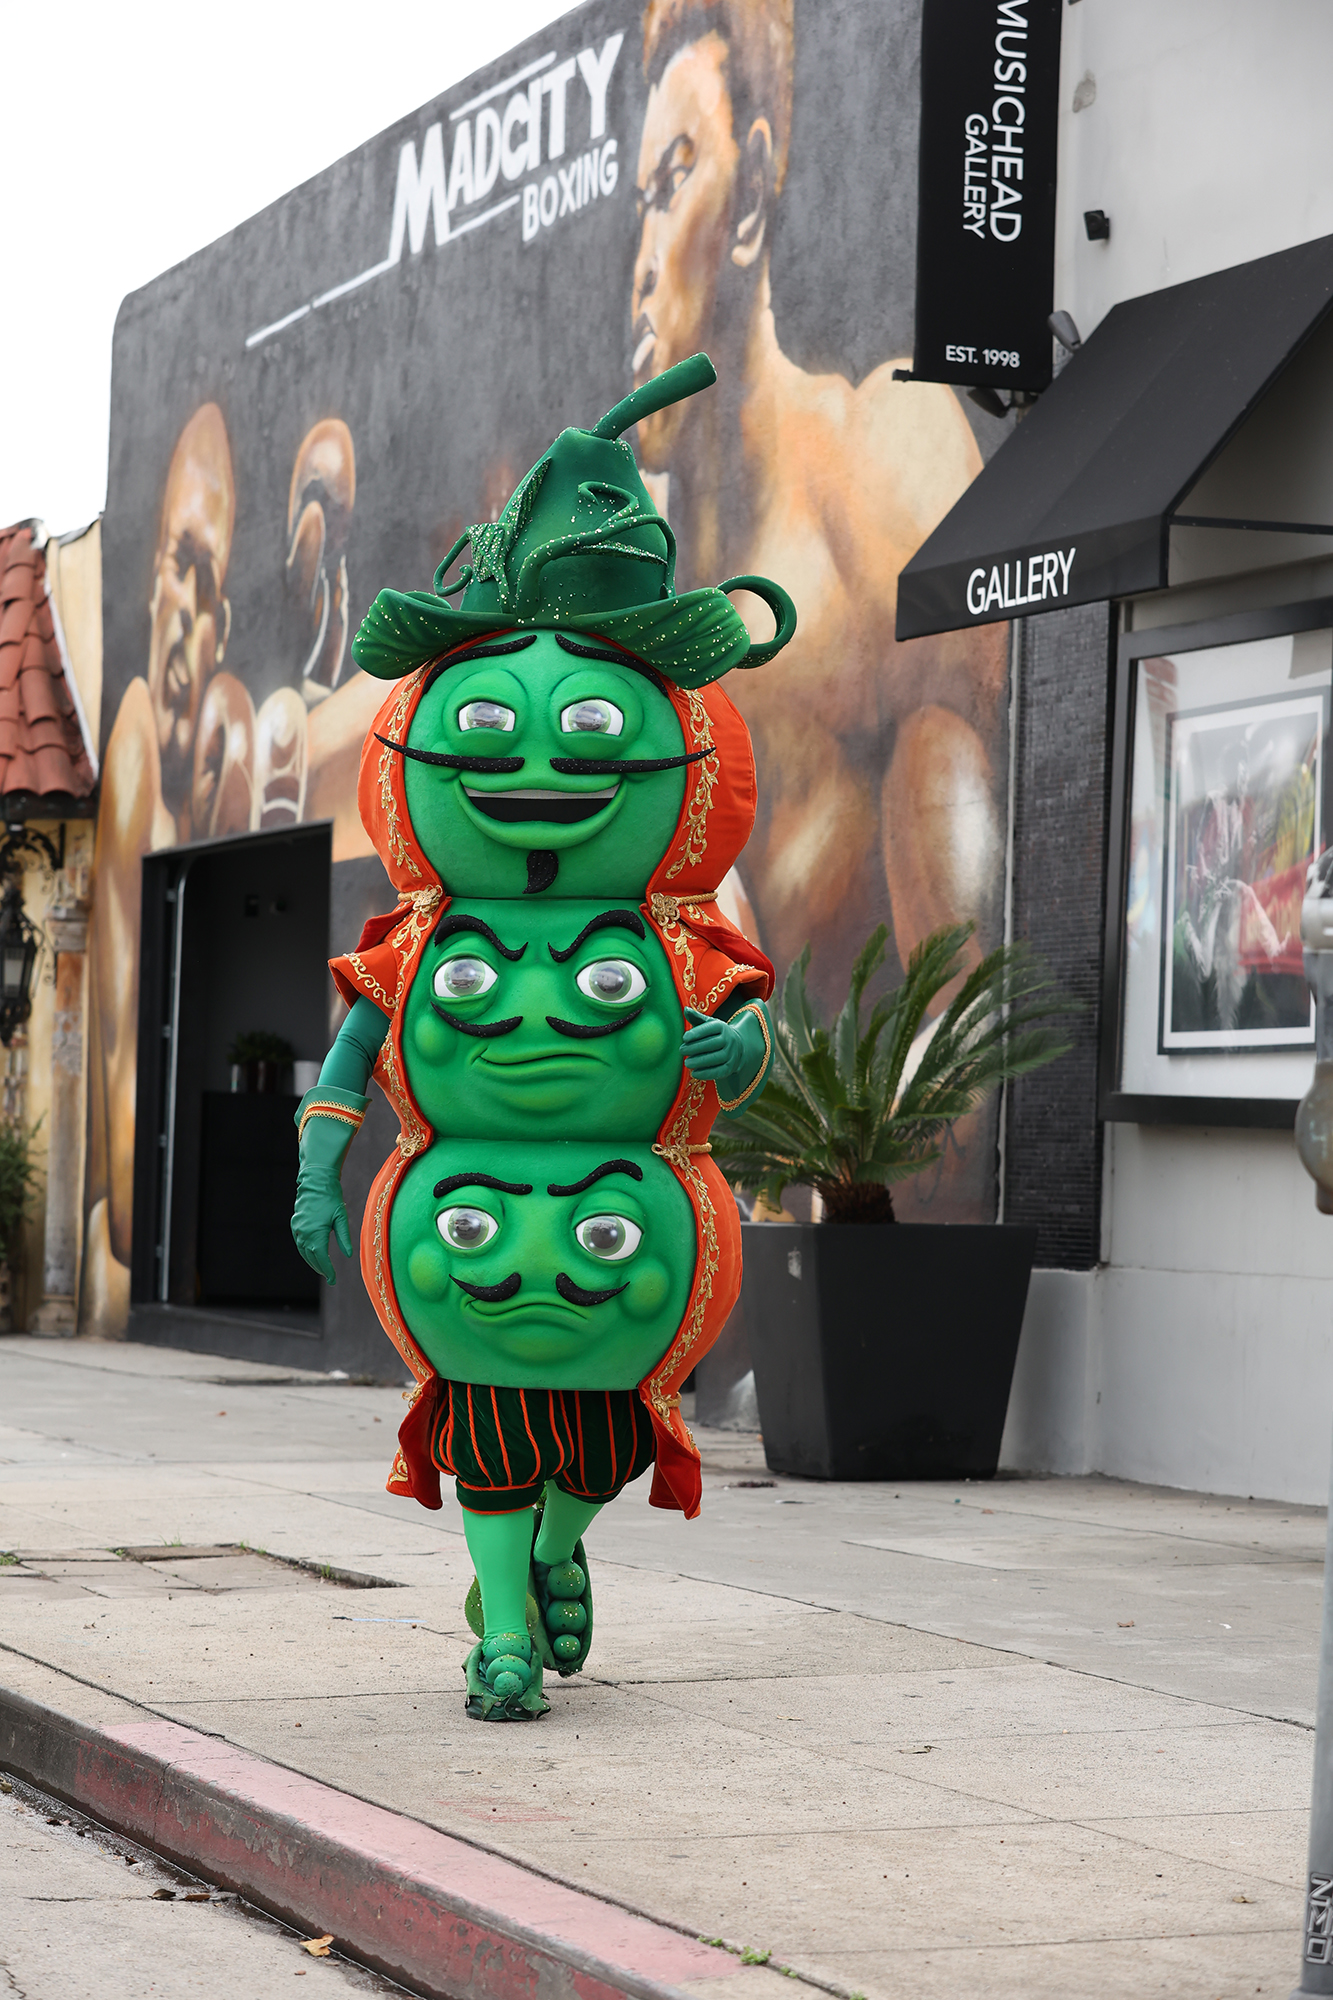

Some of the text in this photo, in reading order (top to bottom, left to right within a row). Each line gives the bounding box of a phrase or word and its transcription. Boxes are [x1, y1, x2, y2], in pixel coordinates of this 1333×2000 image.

[990, 0, 1029, 242] MUSICHEAD
[522, 138, 619, 242] BOXING
[963, 113, 989, 239] GALLERY
[945, 344, 1021, 368] EST. 1998
[966, 547, 1076, 615] GALLERY
